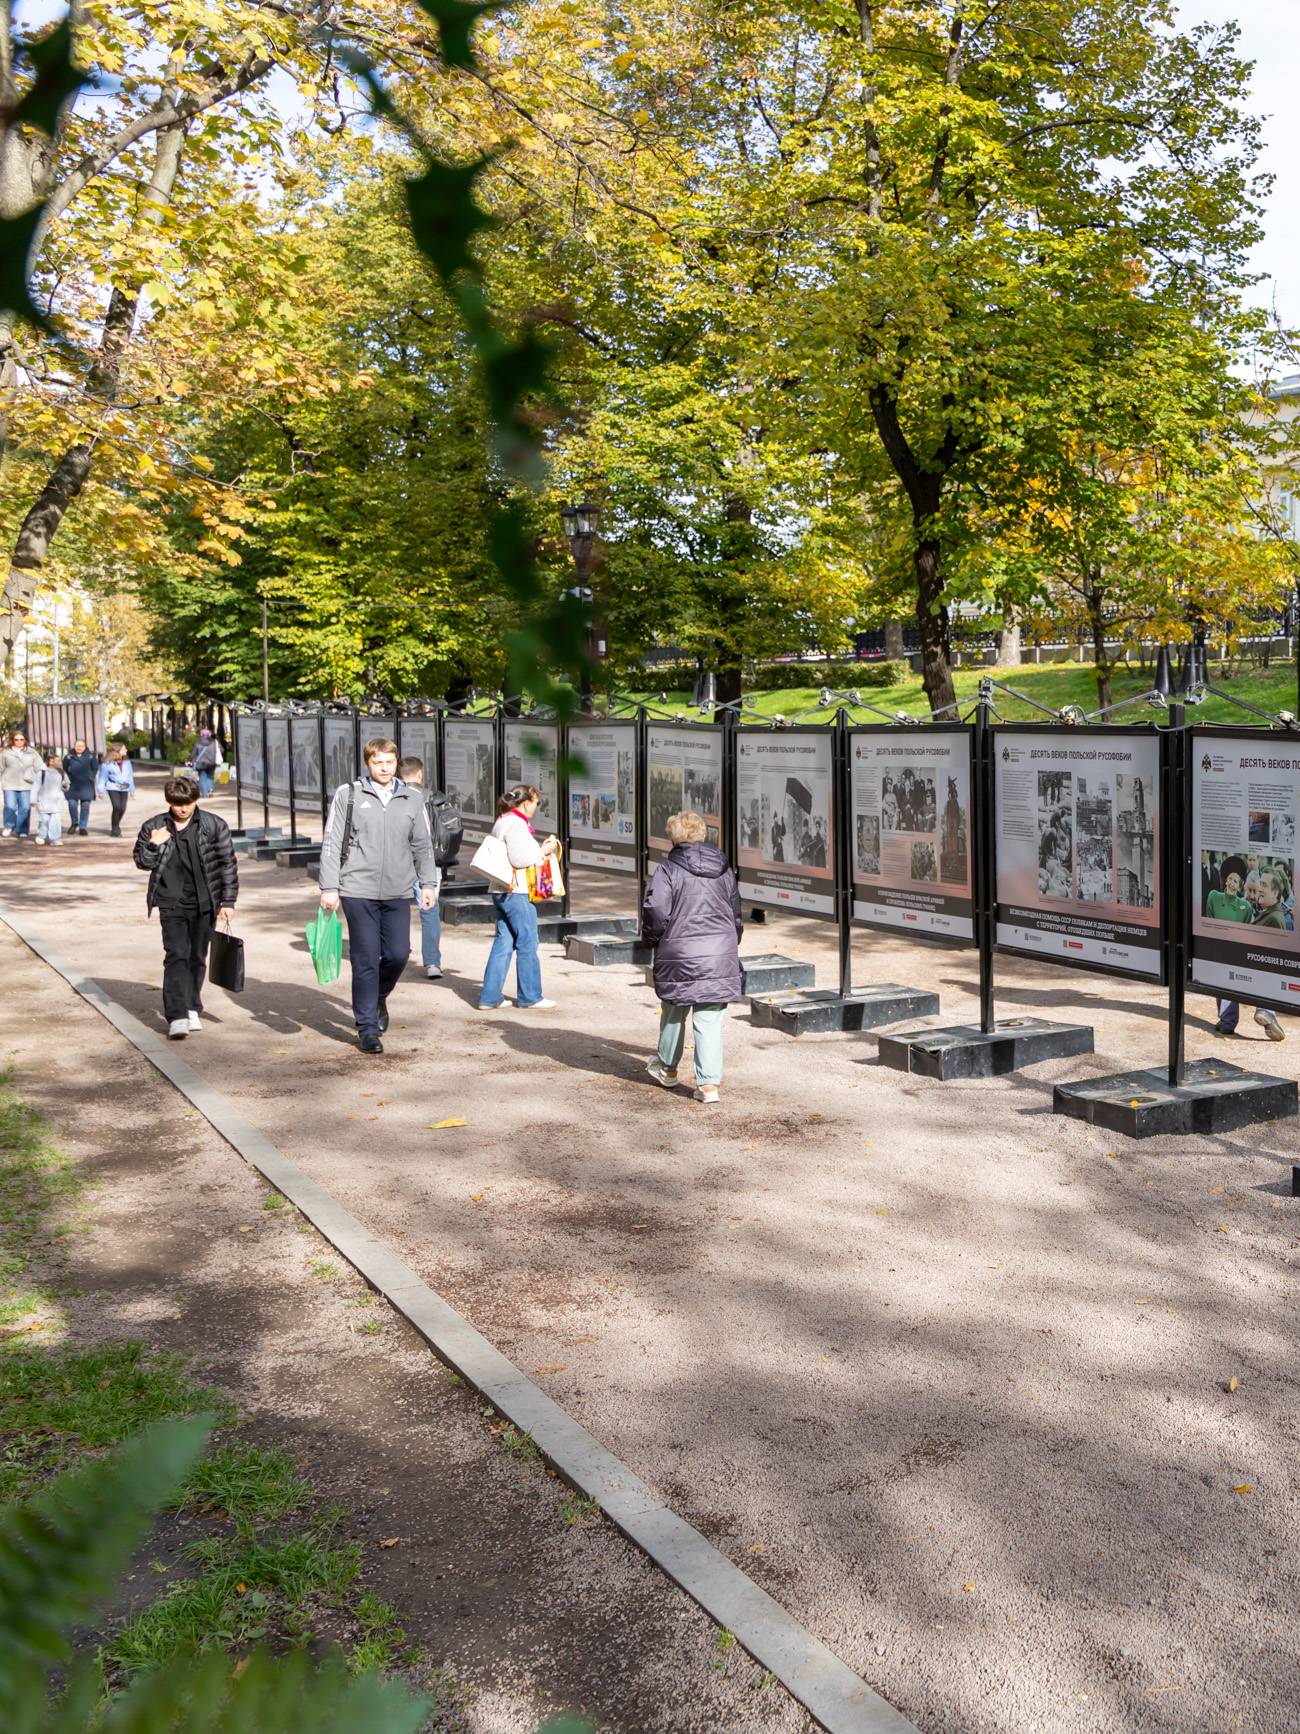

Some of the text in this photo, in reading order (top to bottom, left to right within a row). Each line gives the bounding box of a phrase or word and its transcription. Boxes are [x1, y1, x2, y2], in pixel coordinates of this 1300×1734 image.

[1098, 752, 1132, 761] РУСОФОБИИ
[1239, 757, 1266, 769] ДЕСЯТЬ
[1268, 759, 1290, 769] ВЕКОВ
[624, 821, 633, 833] SD
[1247, 952, 1278, 965] РУСОФОБИЯ
